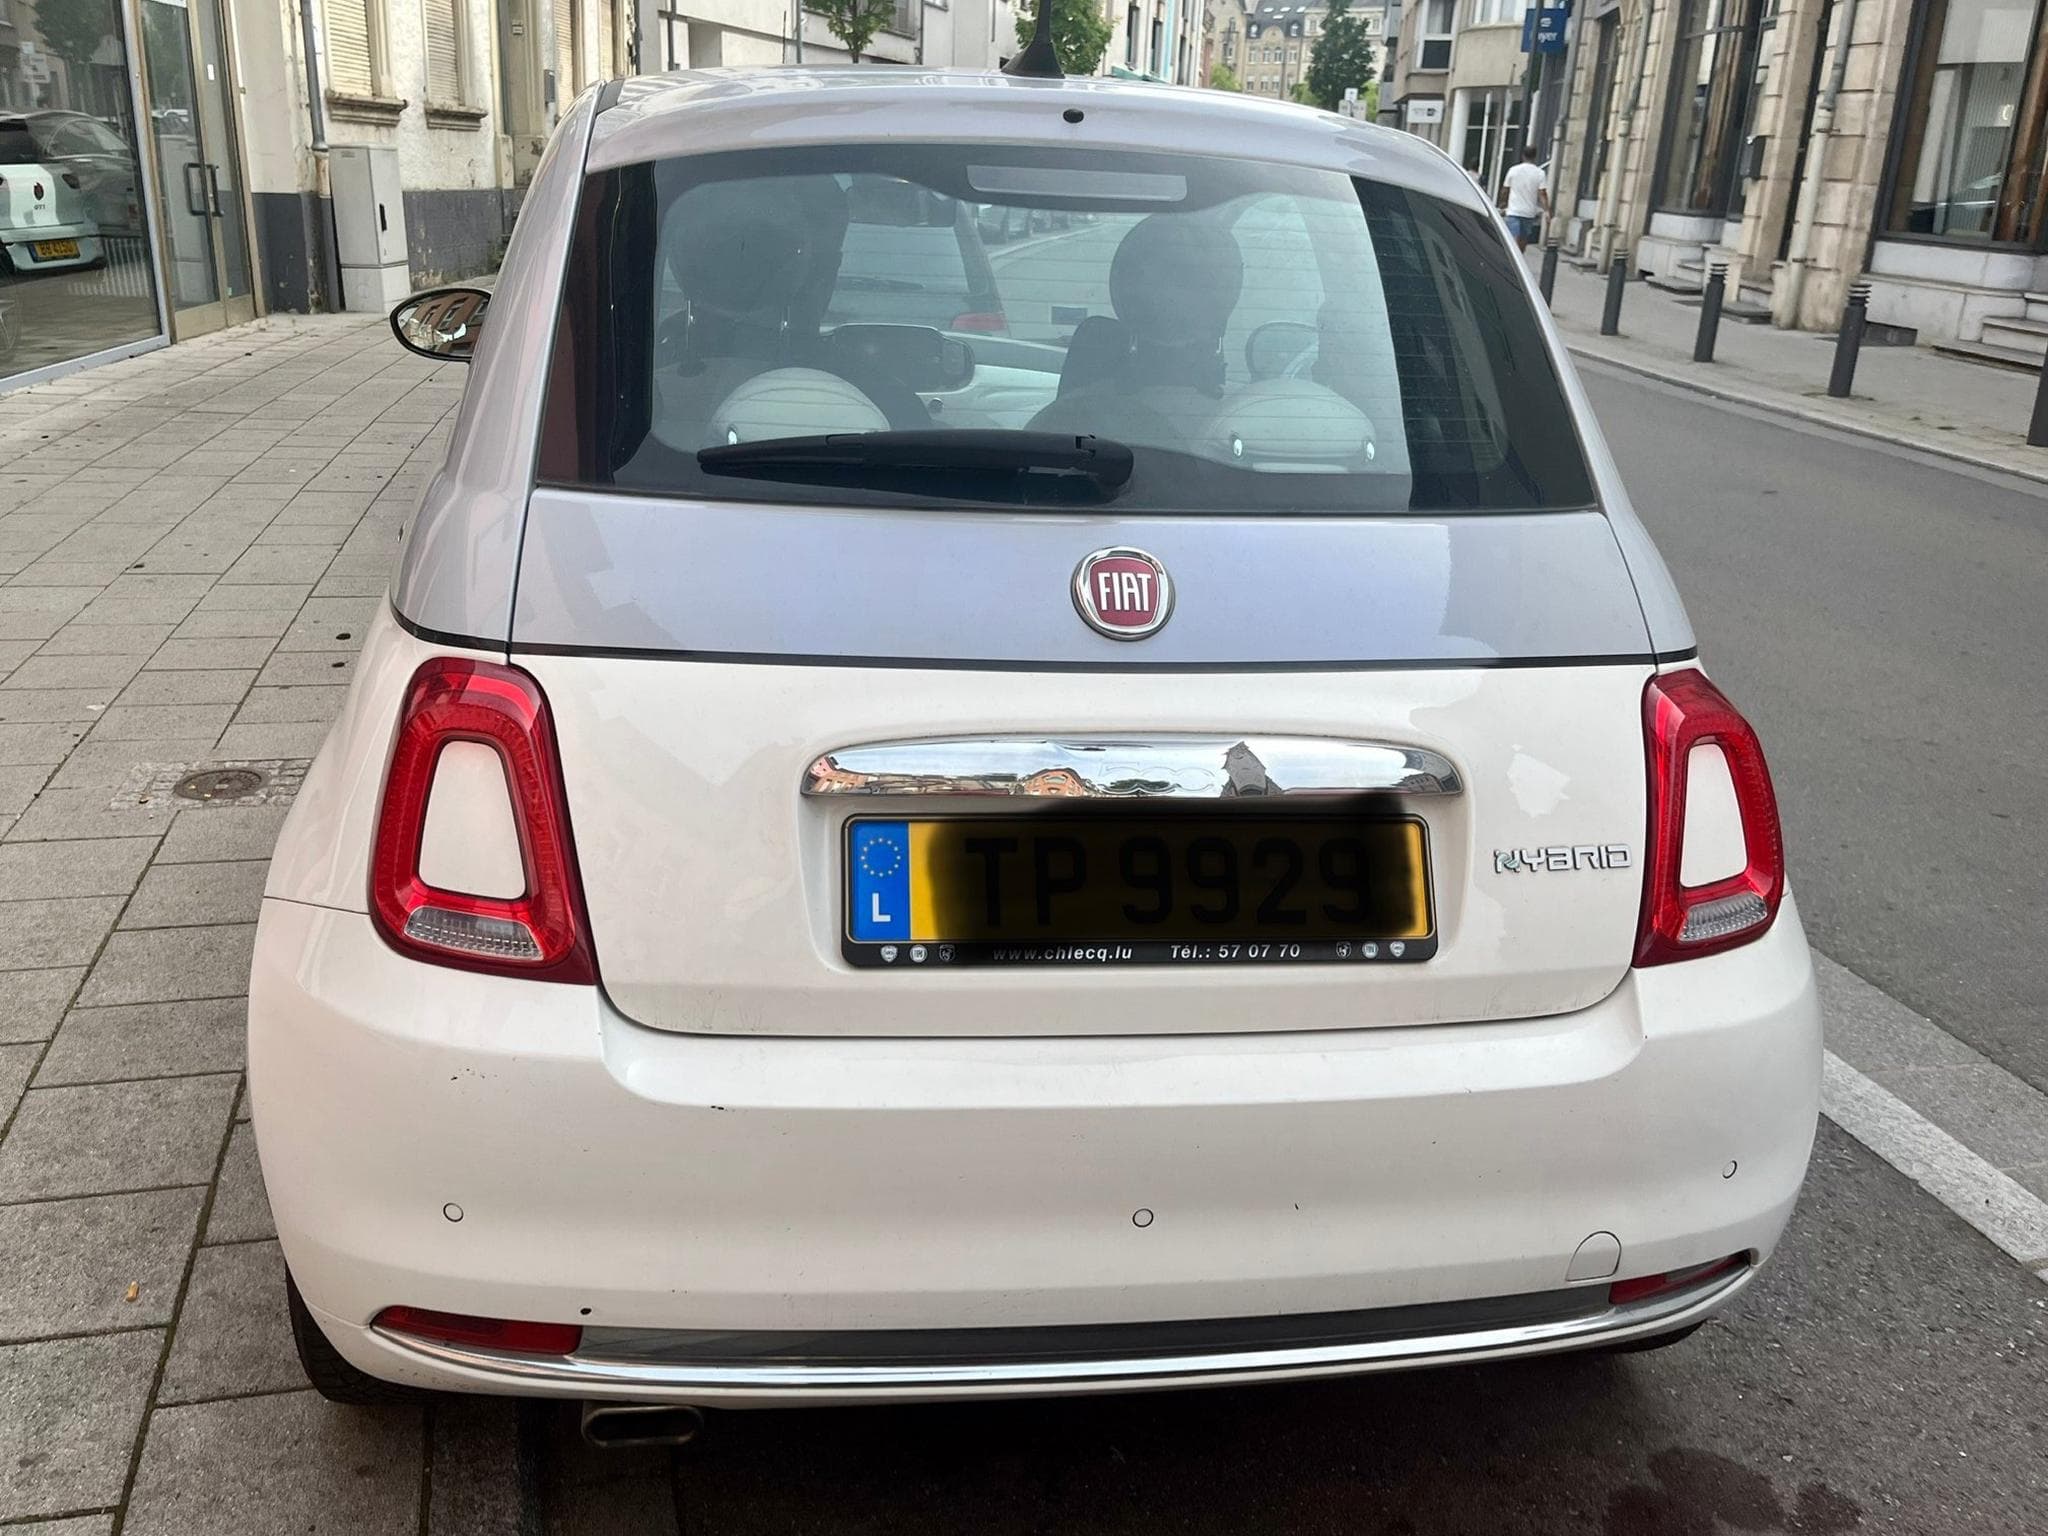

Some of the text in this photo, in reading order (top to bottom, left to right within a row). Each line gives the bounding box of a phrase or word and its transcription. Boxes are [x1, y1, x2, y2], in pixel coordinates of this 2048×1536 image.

[1098, 572, 1151, 612] FIAT
[872, 892, 891, 922] L
[1218, 945, 1242, 958] 57
[1248, 945, 1273, 958] 07
[1279, 945, 1301, 958] 70
